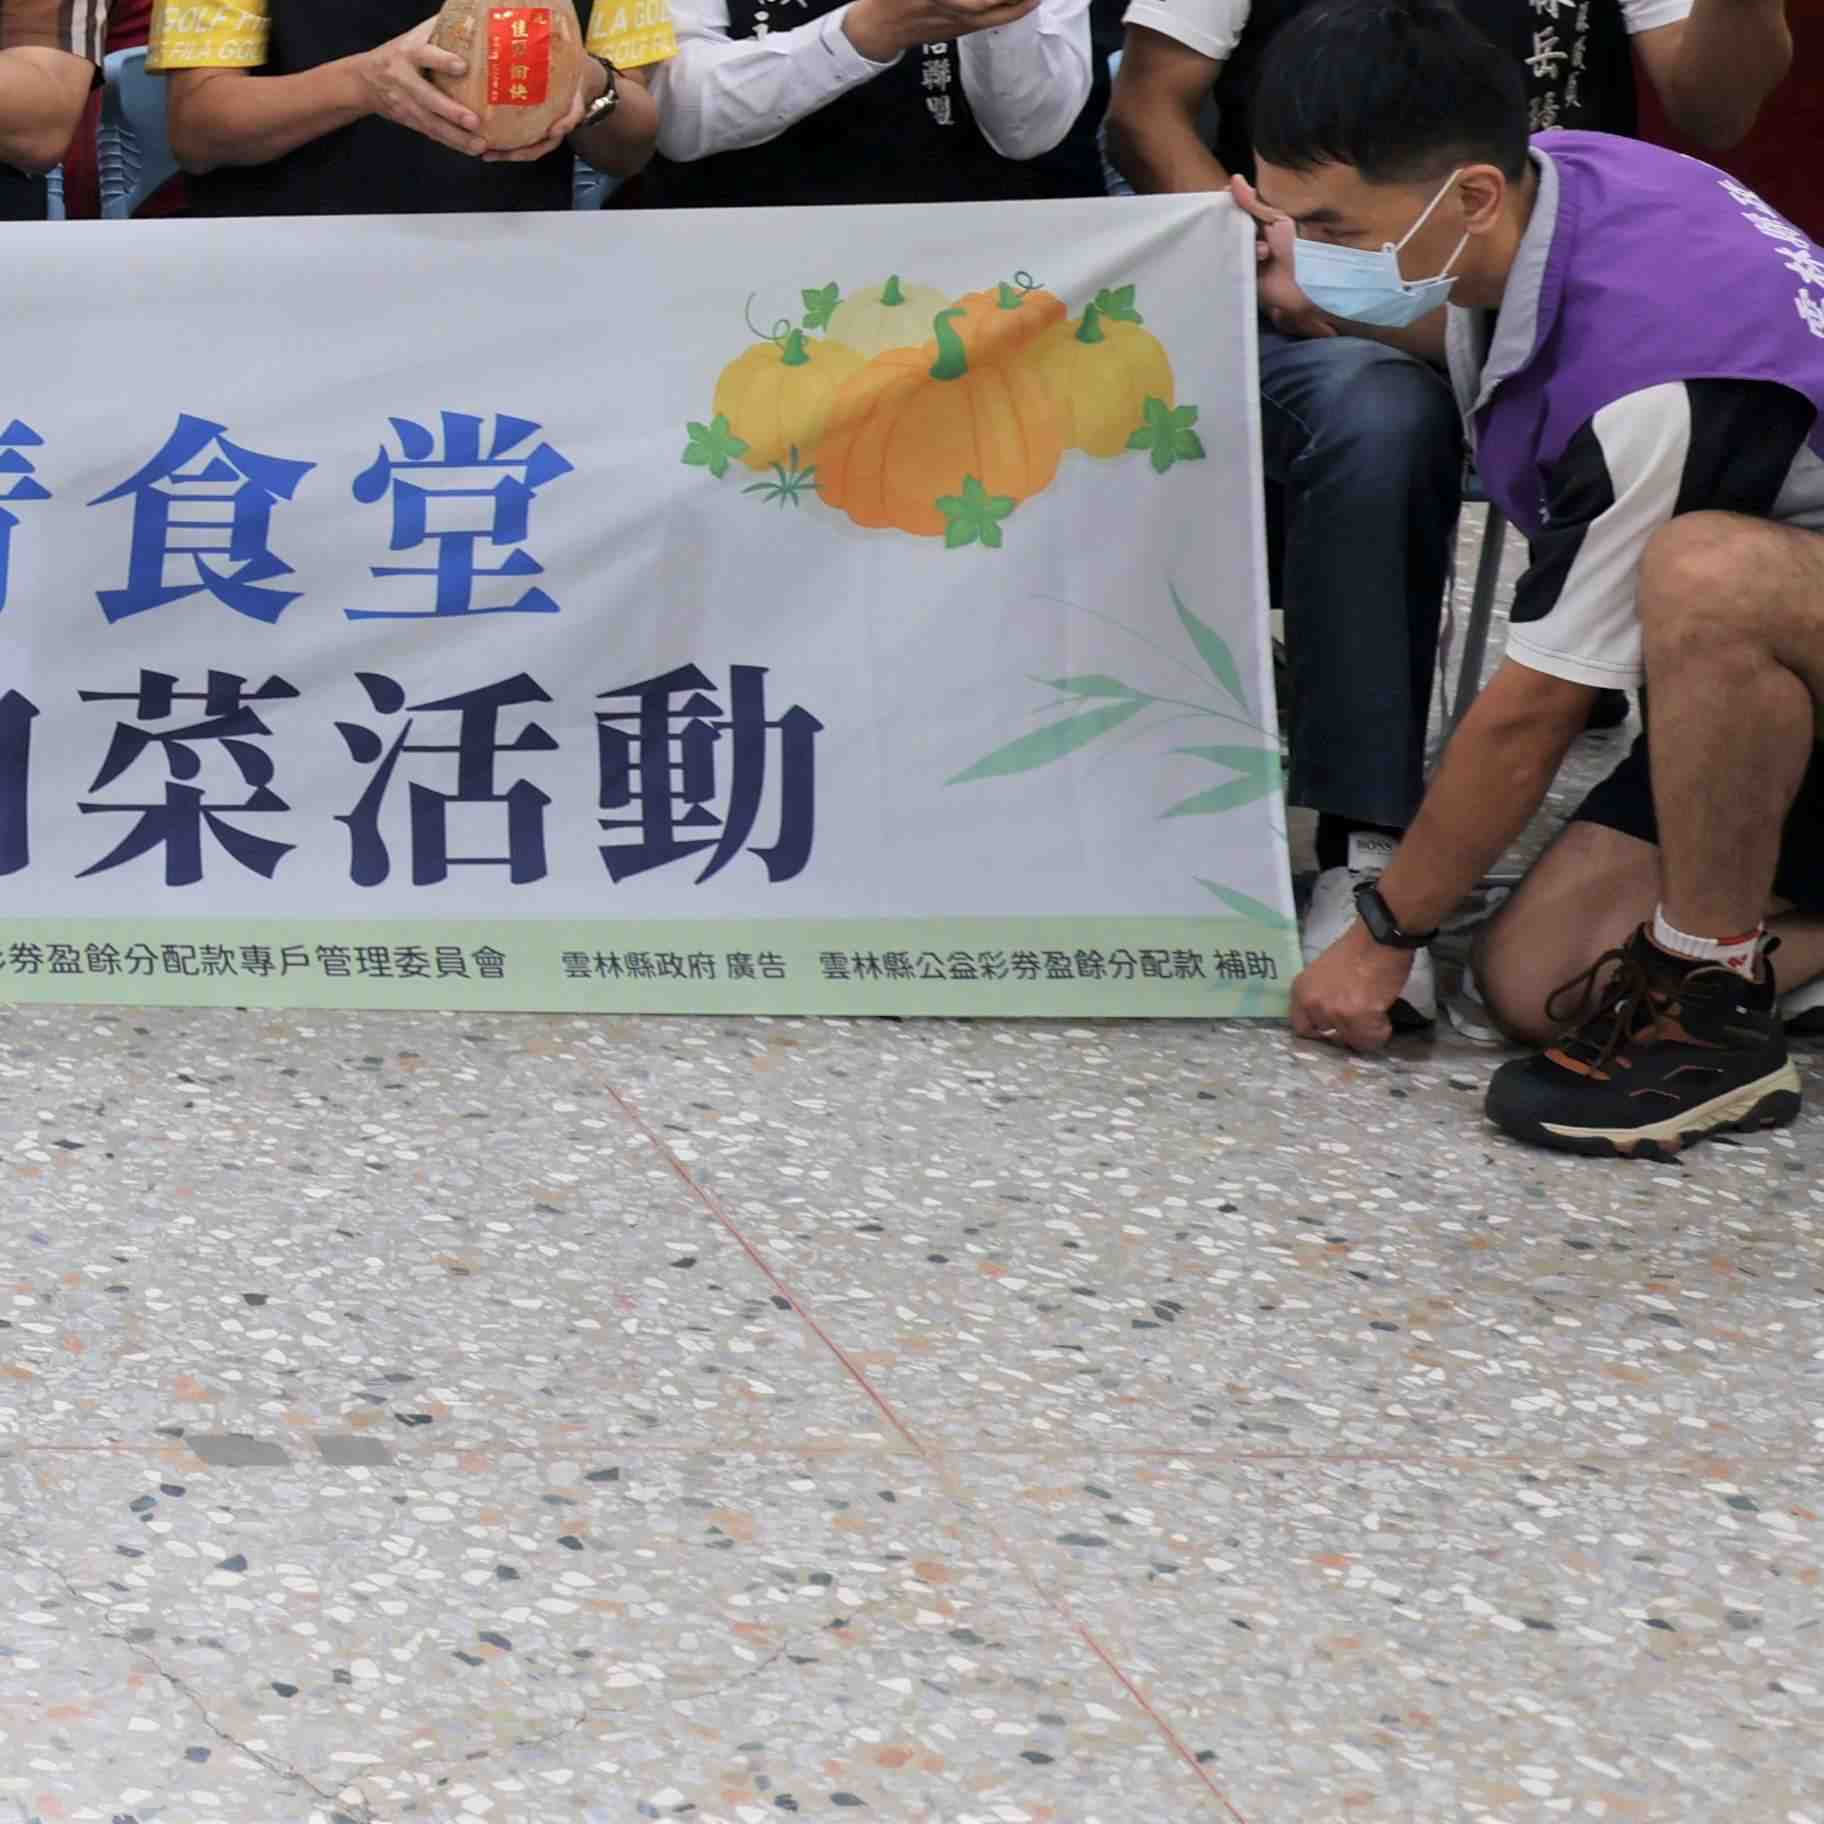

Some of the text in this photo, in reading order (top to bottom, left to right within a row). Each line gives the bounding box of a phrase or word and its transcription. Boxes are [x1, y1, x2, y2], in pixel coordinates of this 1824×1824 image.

[560, 951, 717, 979] 雲林縣政府
[727, 952, 786, 979] 廣告
[818, 949, 1202, 980] 雲林縣公益彩券盈餘分配款
[1213, 949, 1277, 980] 補助
